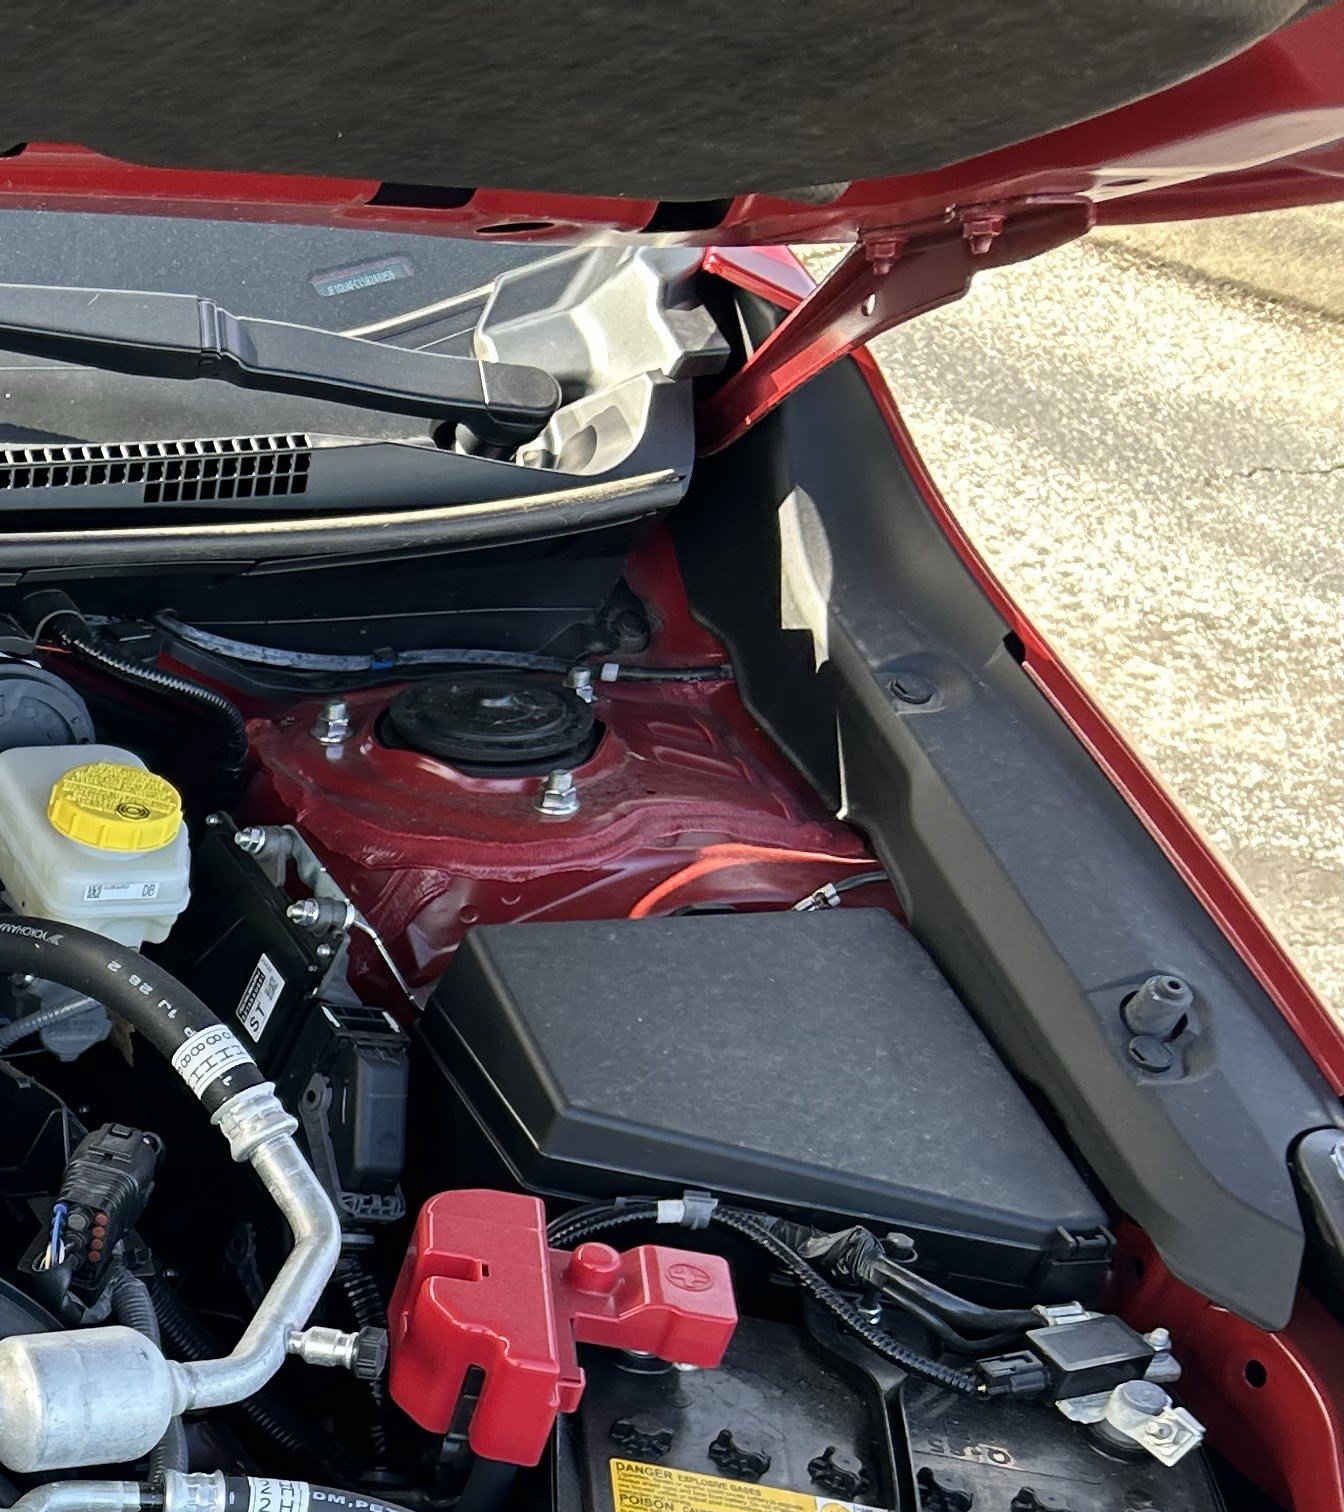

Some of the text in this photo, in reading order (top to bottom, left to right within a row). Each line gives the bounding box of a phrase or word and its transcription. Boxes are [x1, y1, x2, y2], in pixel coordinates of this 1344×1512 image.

[142, 884, 155, 897] DB
[108, 960, 121, 972] 2
[616, 1461, 673, 1480] DANGER
[678, 1474, 728, 1491] EXPLOSIVE
[619, 1494, 674, 1511] POISON
